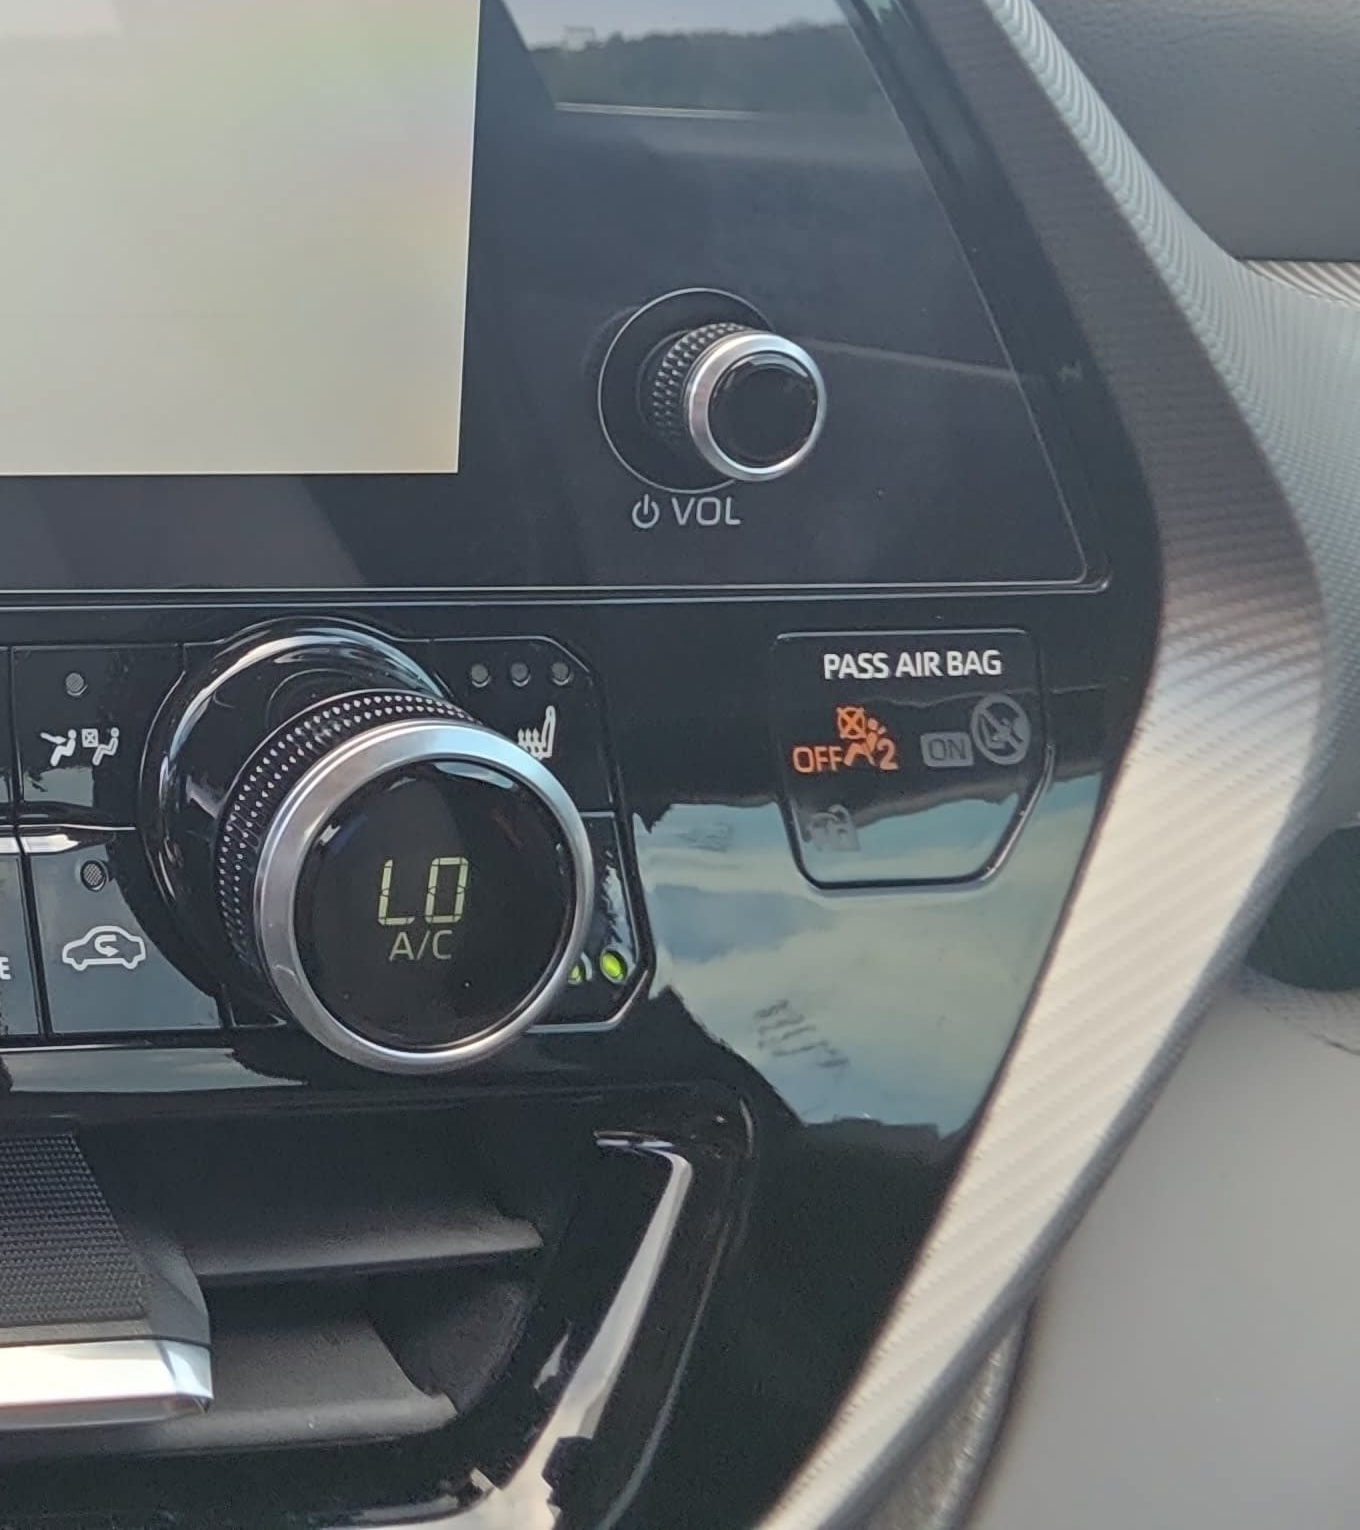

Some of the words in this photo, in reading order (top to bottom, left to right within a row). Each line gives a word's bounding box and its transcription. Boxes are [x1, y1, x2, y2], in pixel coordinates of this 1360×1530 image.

[671, 497, 741, 527] VOL
[824, 652, 888, 680] PASS
[896, 651, 940, 677] AIR
[946, 649, 1002, 678] BAG
[792, 746, 844, 774] OFF
[929, 738, 969, 762] ON
[378, 856, 469, 928] LO
[389, 928, 453, 961] A/C
